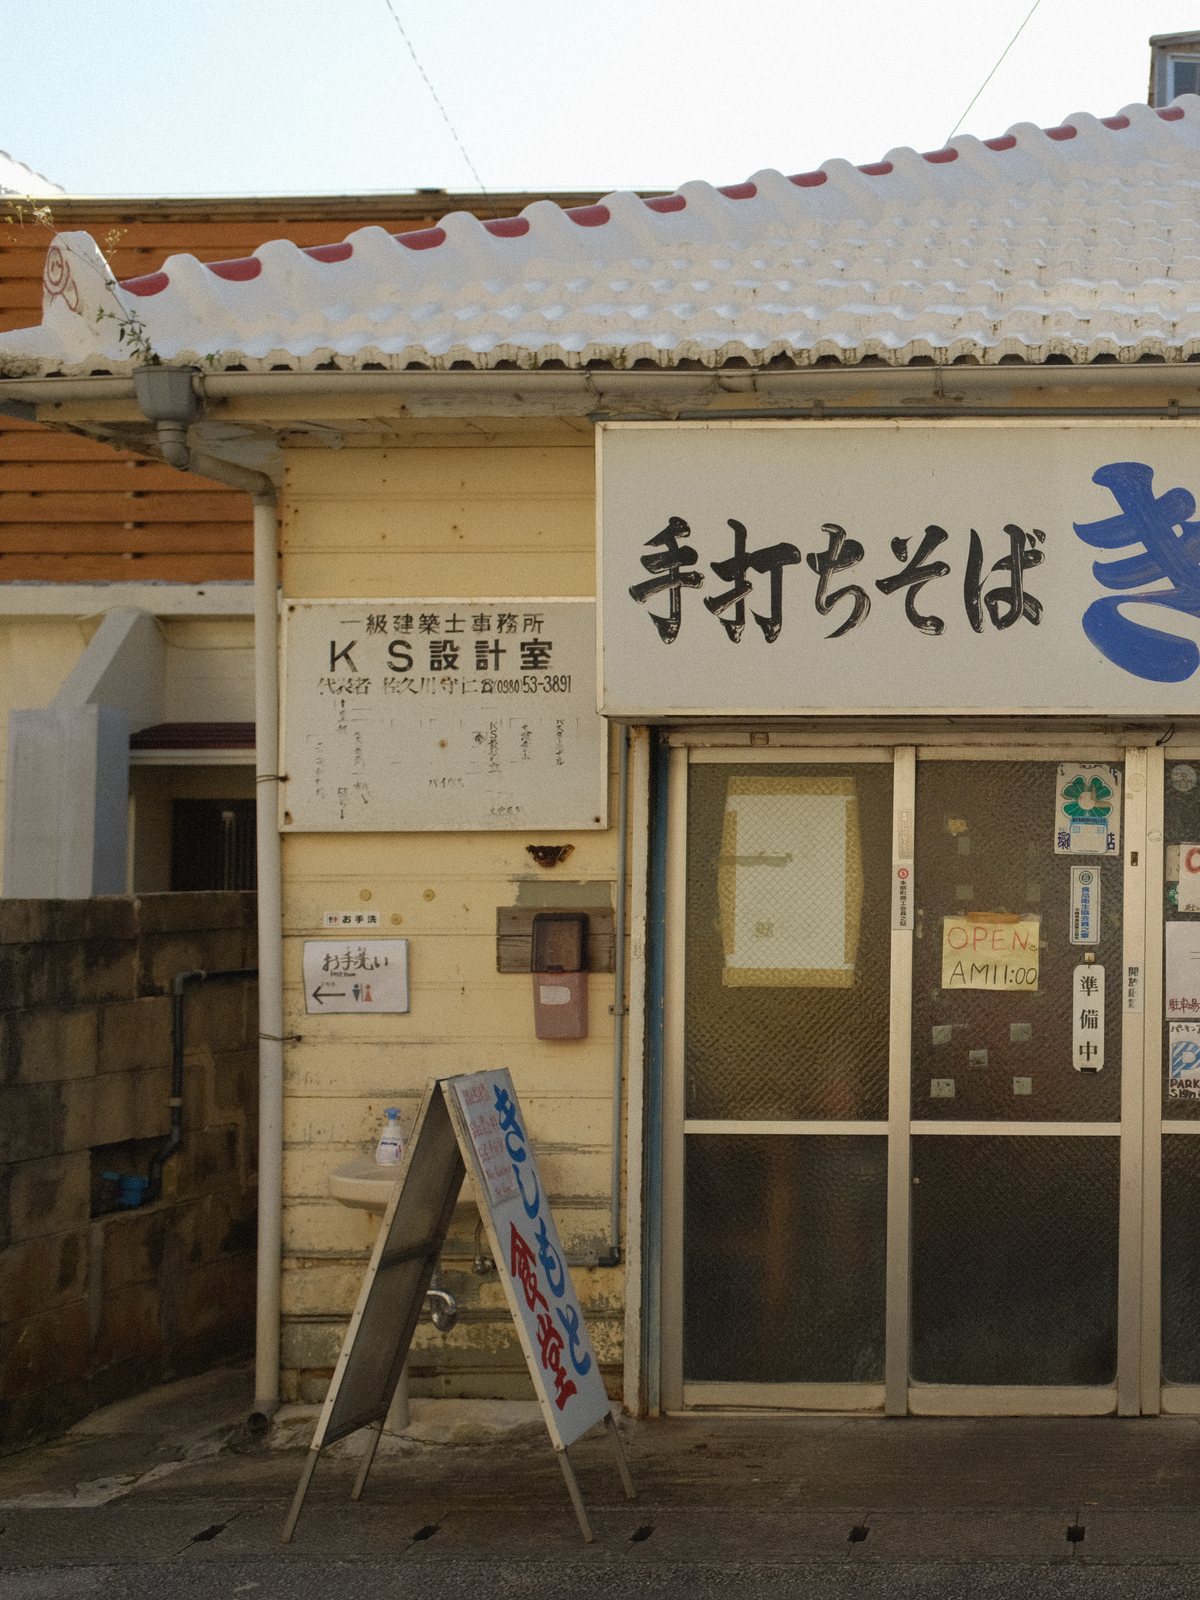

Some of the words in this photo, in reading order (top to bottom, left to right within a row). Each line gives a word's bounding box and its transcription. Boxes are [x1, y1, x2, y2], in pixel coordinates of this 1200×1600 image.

[340, 612, 545, 634] 一級建築士事務所
[628, 516, 1048, 645] 手打ちそば
[322, 951, 389, 971] お手洗い
[948, 927, 1029, 952] OPEN
[1079, 975, 1099, 1062] 準備中
[493, 1084, 592, 1376] きしもと
[510, 1221, 578, 1411] 食堂
